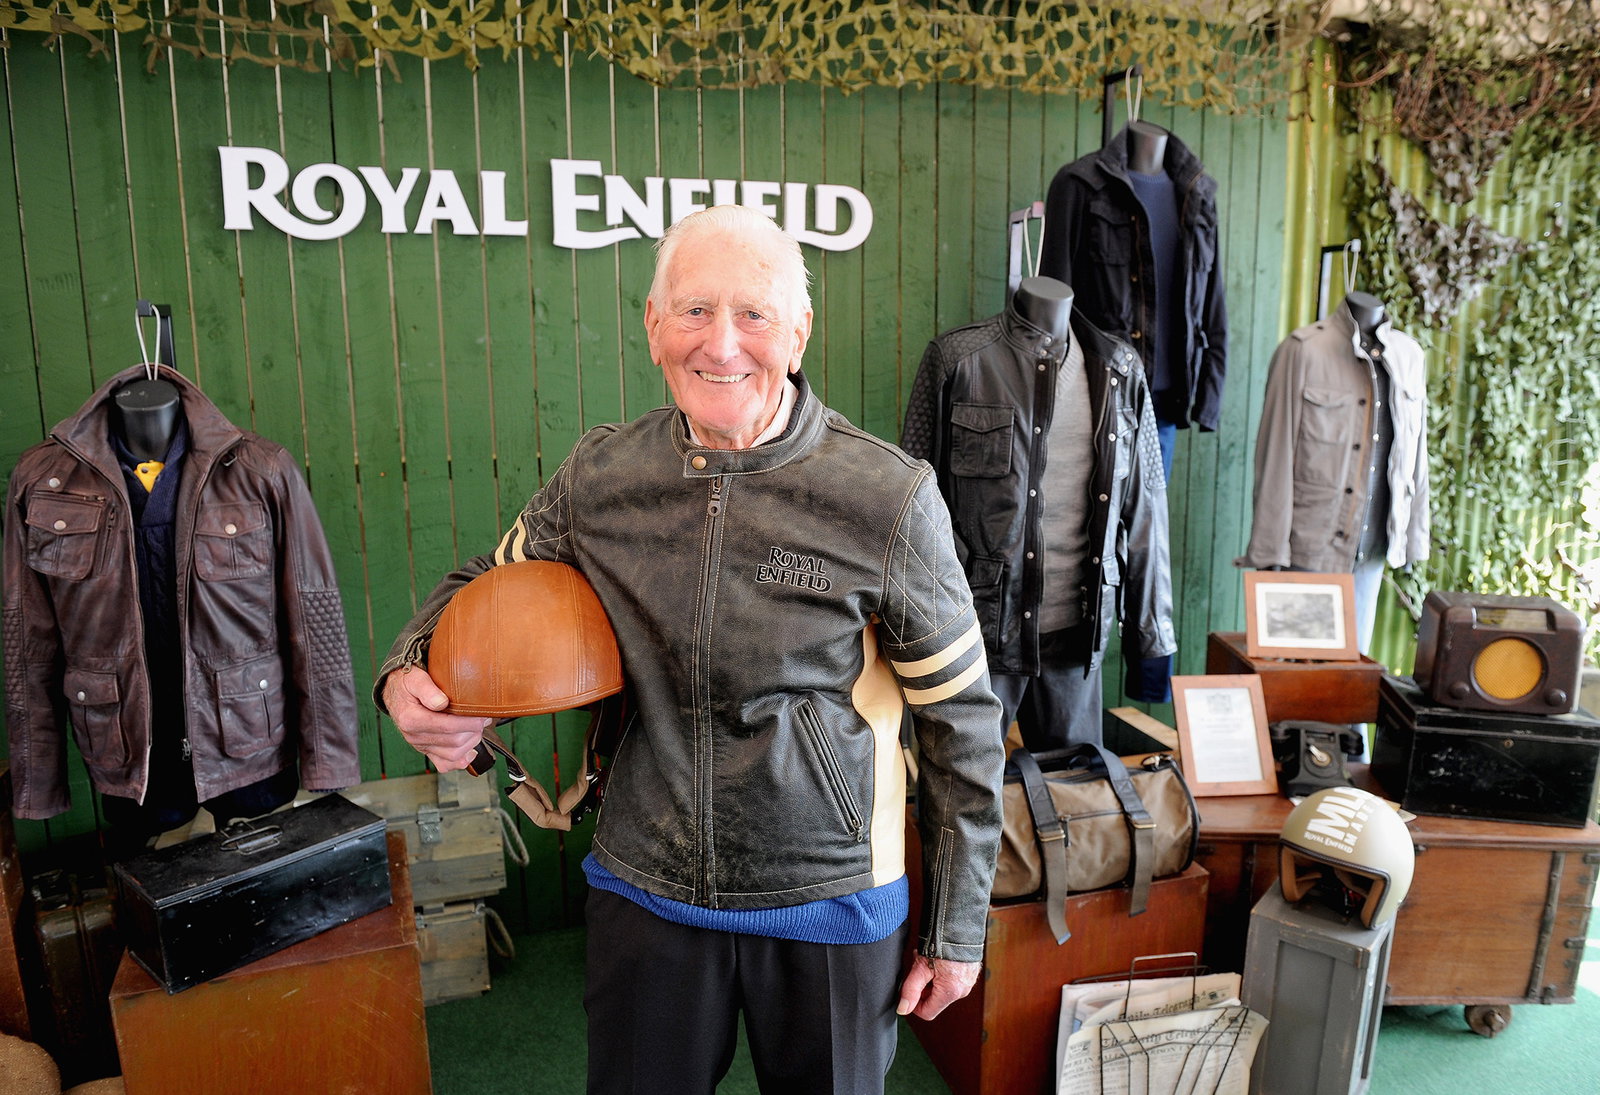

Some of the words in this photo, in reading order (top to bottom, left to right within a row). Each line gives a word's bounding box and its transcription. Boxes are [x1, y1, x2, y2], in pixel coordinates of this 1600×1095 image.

[217, 146, 528, 241] ROYAL
[769, 546, 826, 575] ROYAL
[755, 564, 832, 593] ENFIELD
[1303, 831, 1324, 844] ROYAL
[1324, 837, 1354, 854] ENFIELD
